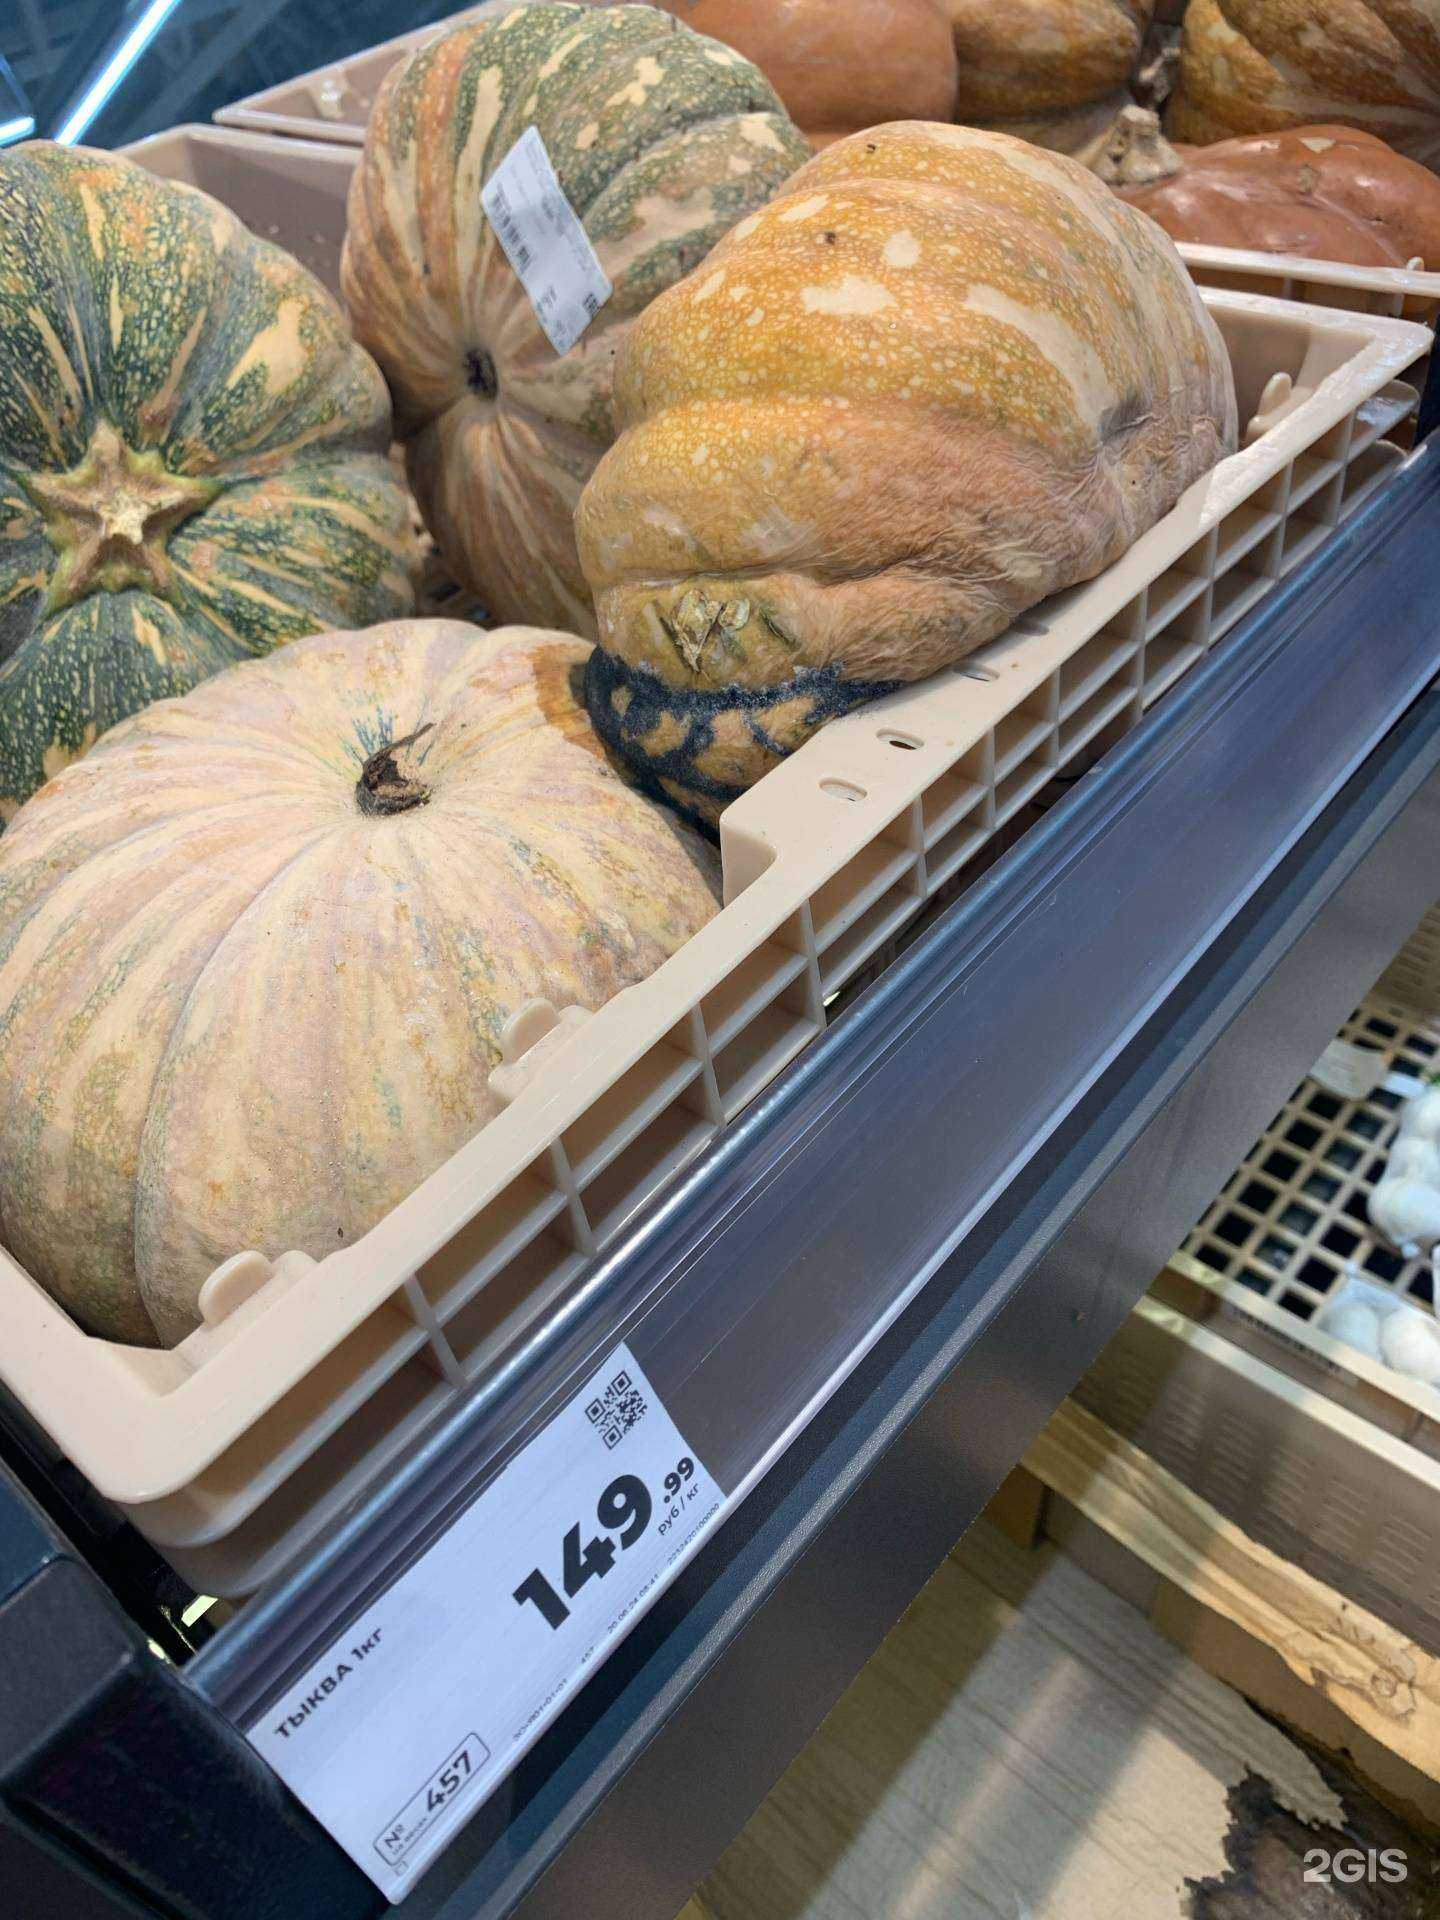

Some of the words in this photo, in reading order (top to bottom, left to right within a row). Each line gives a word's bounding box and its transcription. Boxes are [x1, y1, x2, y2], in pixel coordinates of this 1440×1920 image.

[658, 1506, 680, 1536] руб
[687, 1483, 699, 1501] кг
[512, 1475, 652, 1631] 149
[274, 1664, 353, 1737] ТЫКВА
[351, 1628, 381, 1660] 1кг
[428, 1750, 471, 1811] 457
